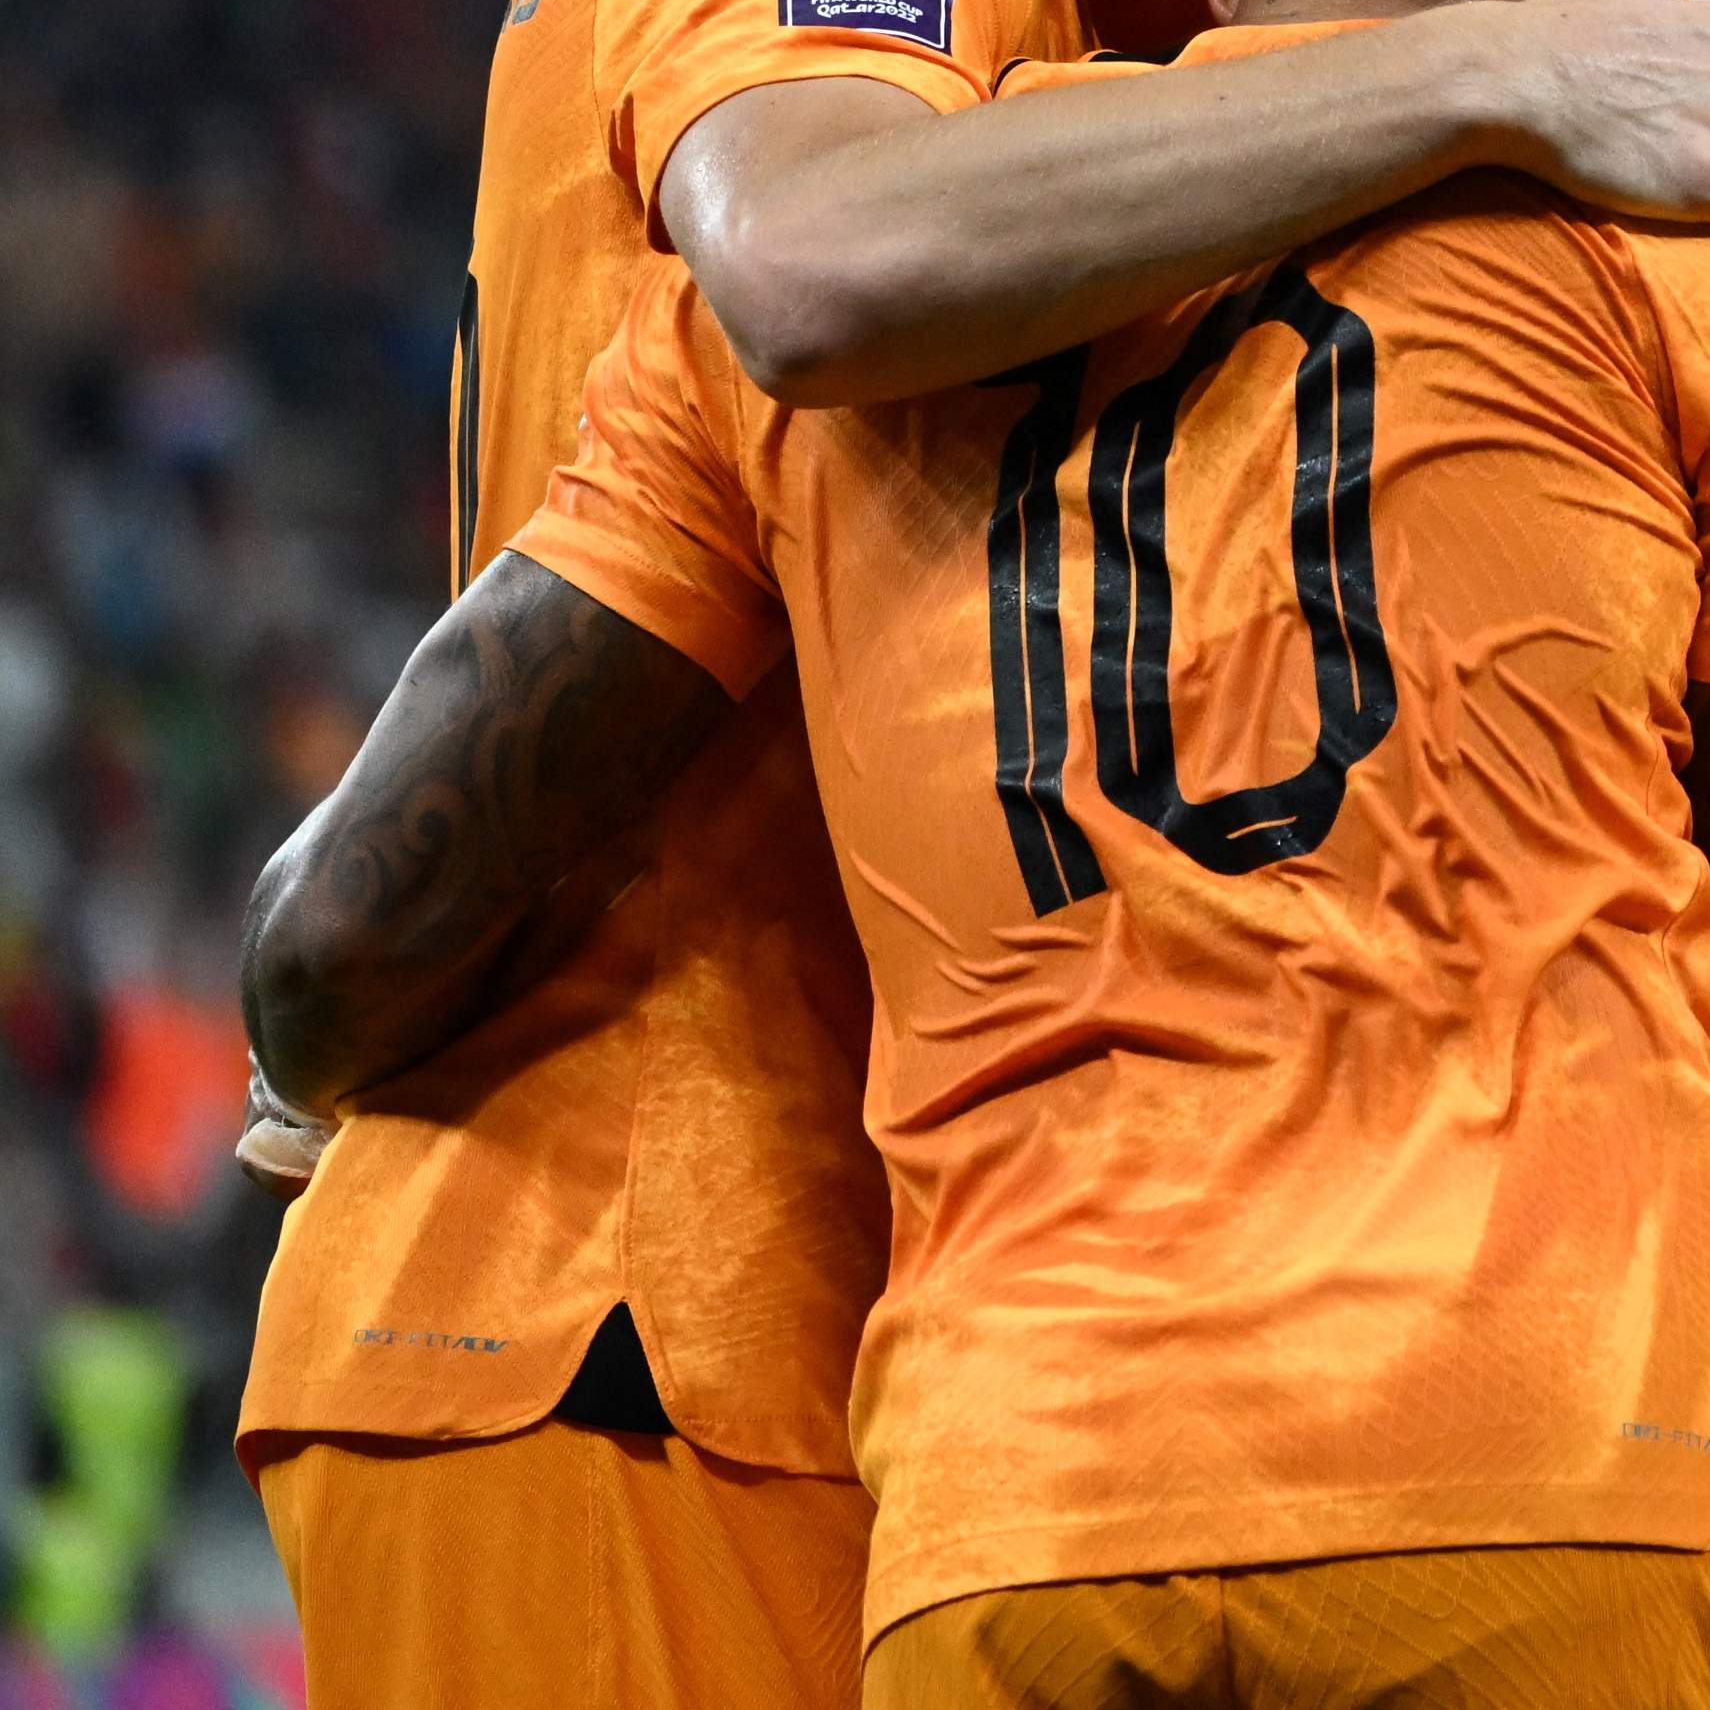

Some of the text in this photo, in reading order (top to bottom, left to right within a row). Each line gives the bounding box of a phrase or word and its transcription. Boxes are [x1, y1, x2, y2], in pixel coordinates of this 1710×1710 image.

[817, 2, 917, 23] Qatar2022
[897, 1, 924, 16] CUP
[972, 266, 1399, 919] 10
